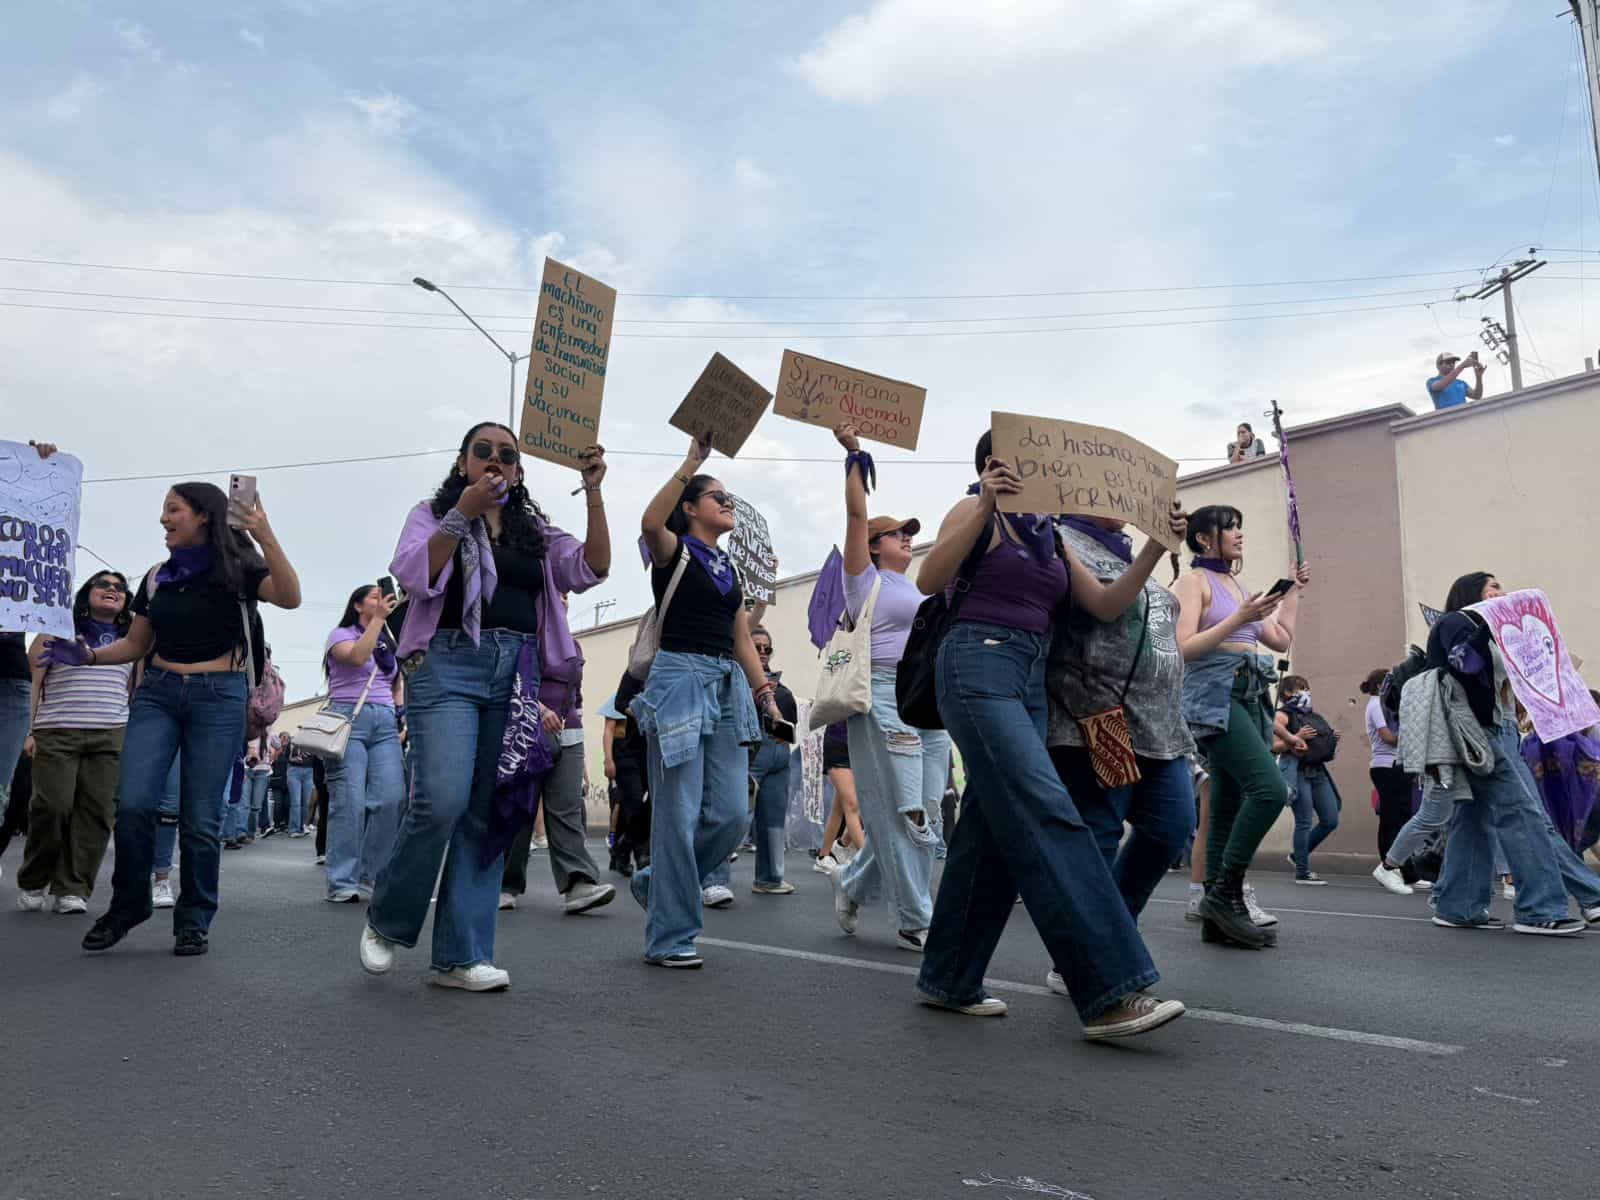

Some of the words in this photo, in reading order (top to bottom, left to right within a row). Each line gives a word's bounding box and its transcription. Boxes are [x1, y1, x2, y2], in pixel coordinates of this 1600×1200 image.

[543, 281, 604, 322] machismo
[548, 303, 564, 321] es
[571, 314, 597, 336] una
[535, 337, 550, 354] de
[540, 320, 609, 360] enfermedad
[534, 376, 544, 397] y
[547, 416, 562, 438] la
